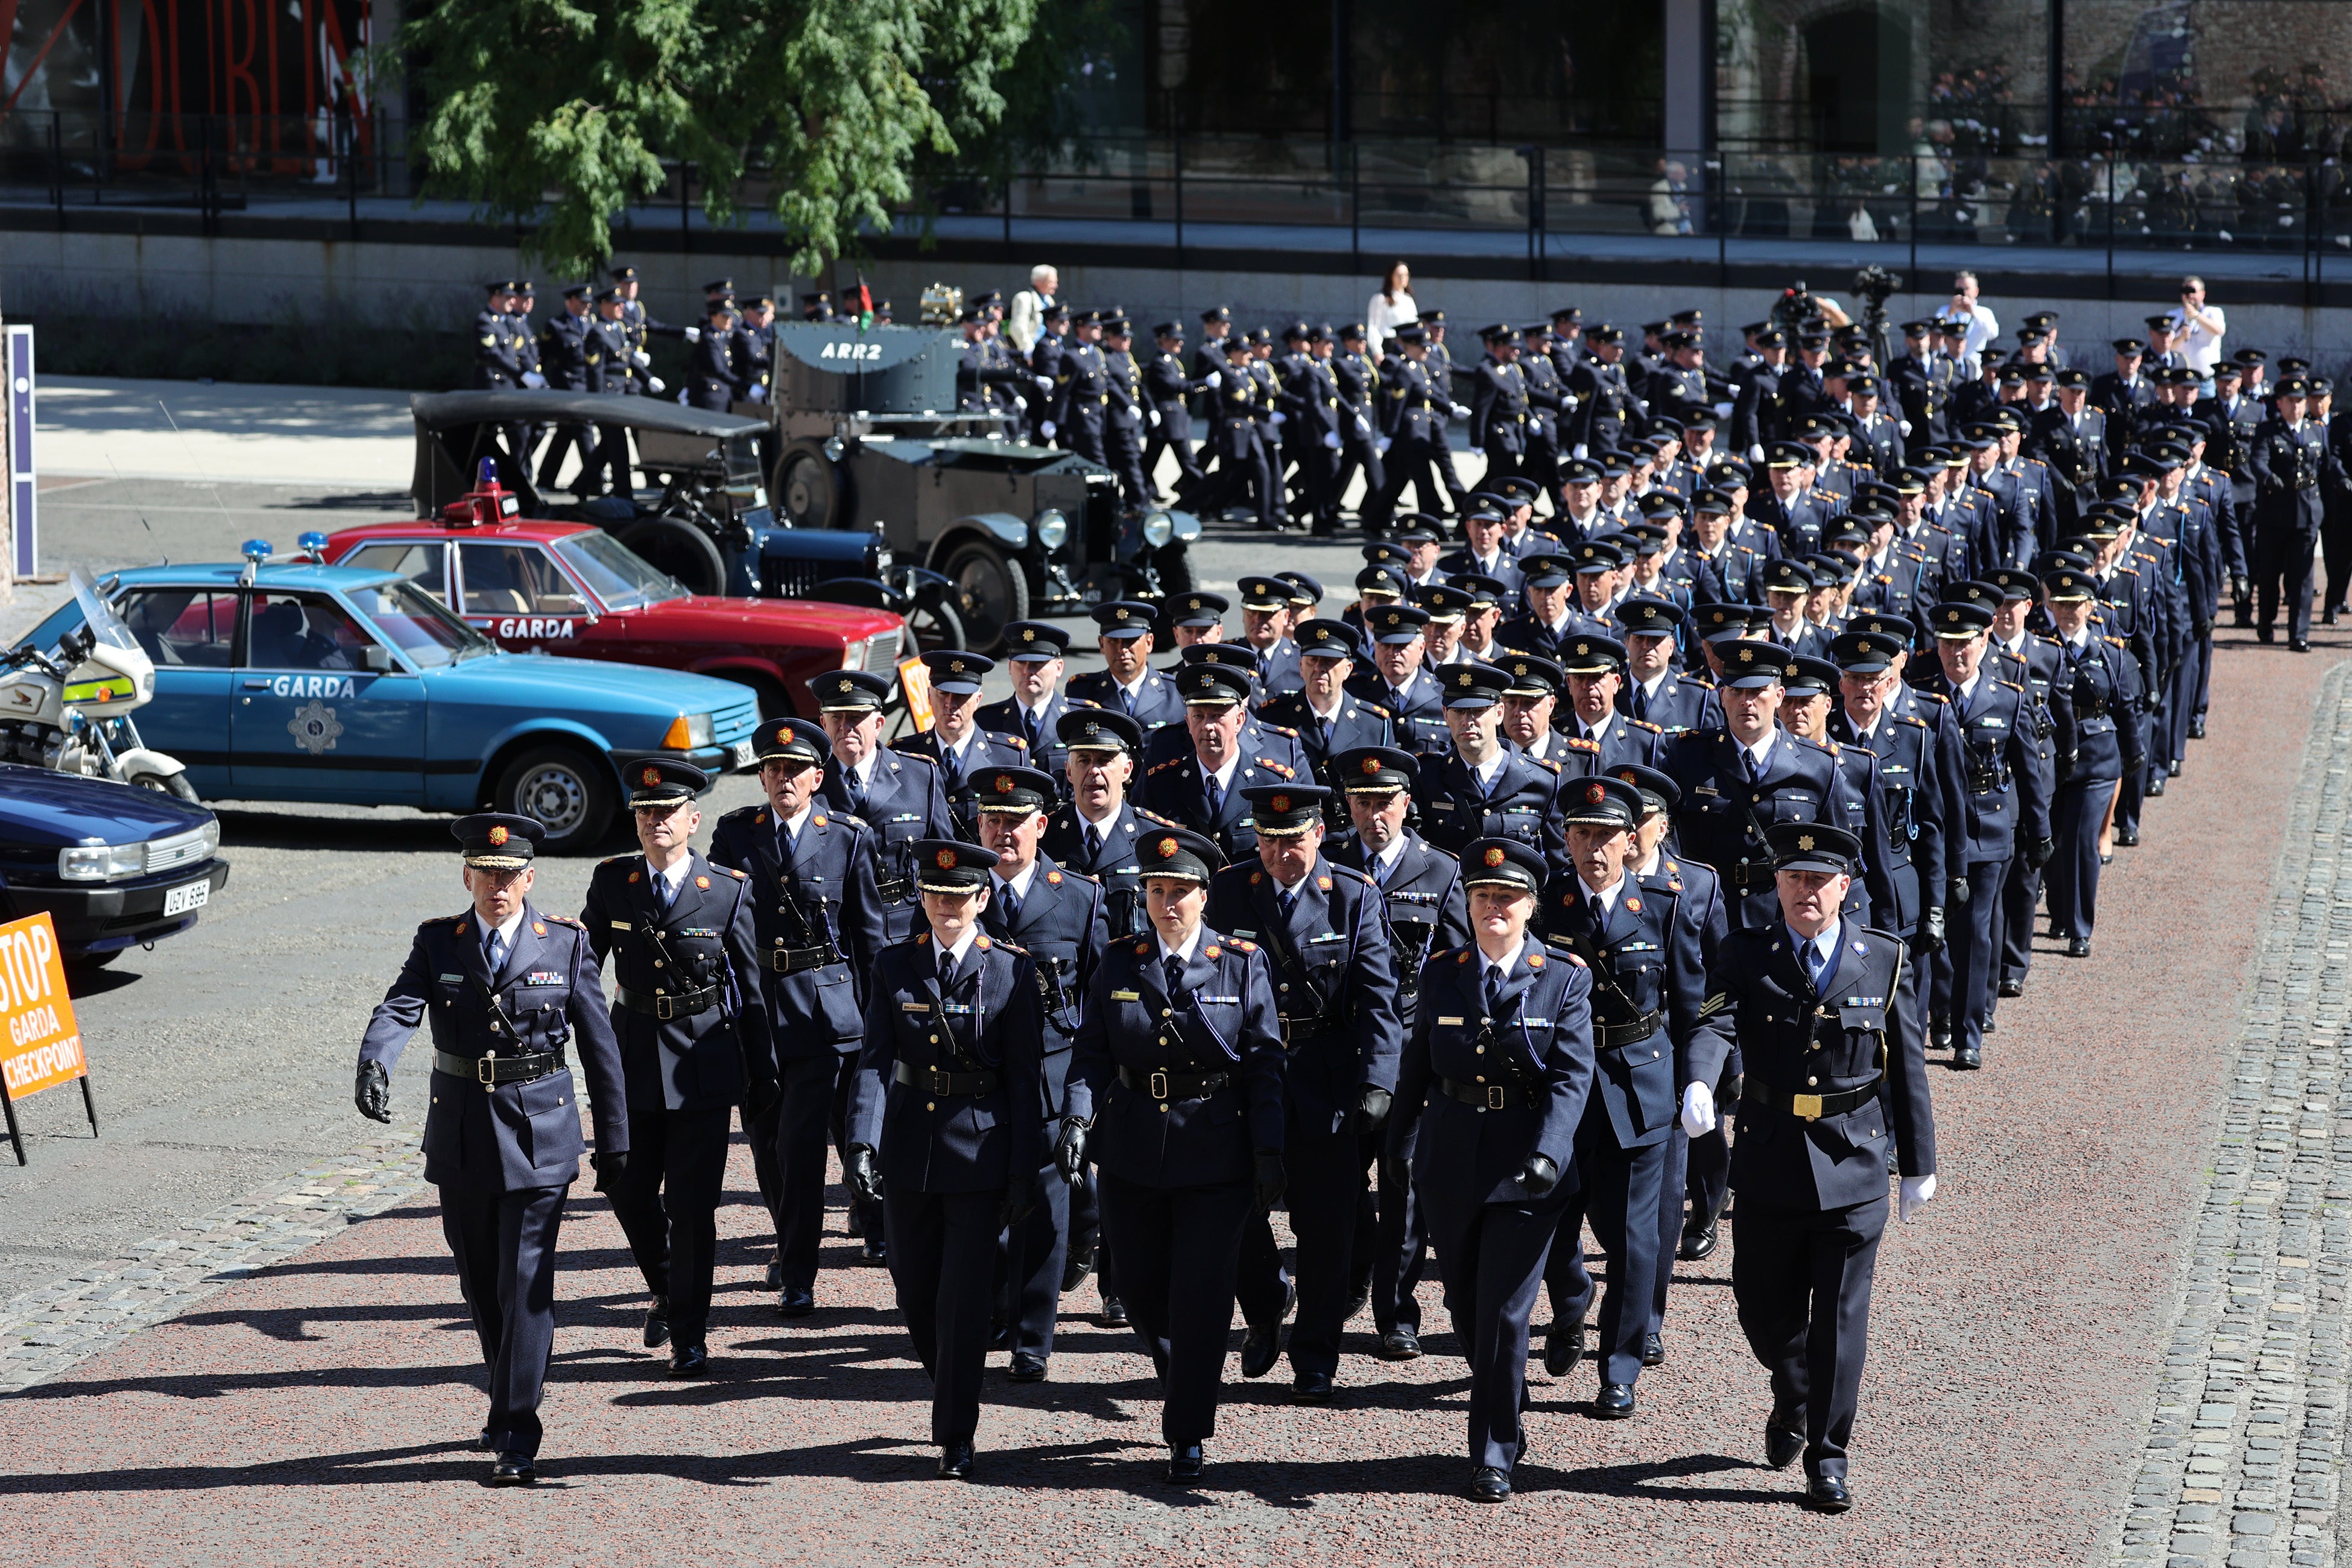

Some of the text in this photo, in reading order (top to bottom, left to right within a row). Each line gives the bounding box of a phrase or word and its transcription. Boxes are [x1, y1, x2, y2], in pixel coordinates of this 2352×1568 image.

[112, 0, 374, 176] DUBLIN
[820, 342, 882, 360] ARR2
[499, 618, 574, 639] GARDA
[273, 675, 355, 698] GARDA
[190, 885, 206, 906] 685
[9, 1004, 62, 1047] GARDA
[4, 1035, 81, 1090] CHECKPOINT
